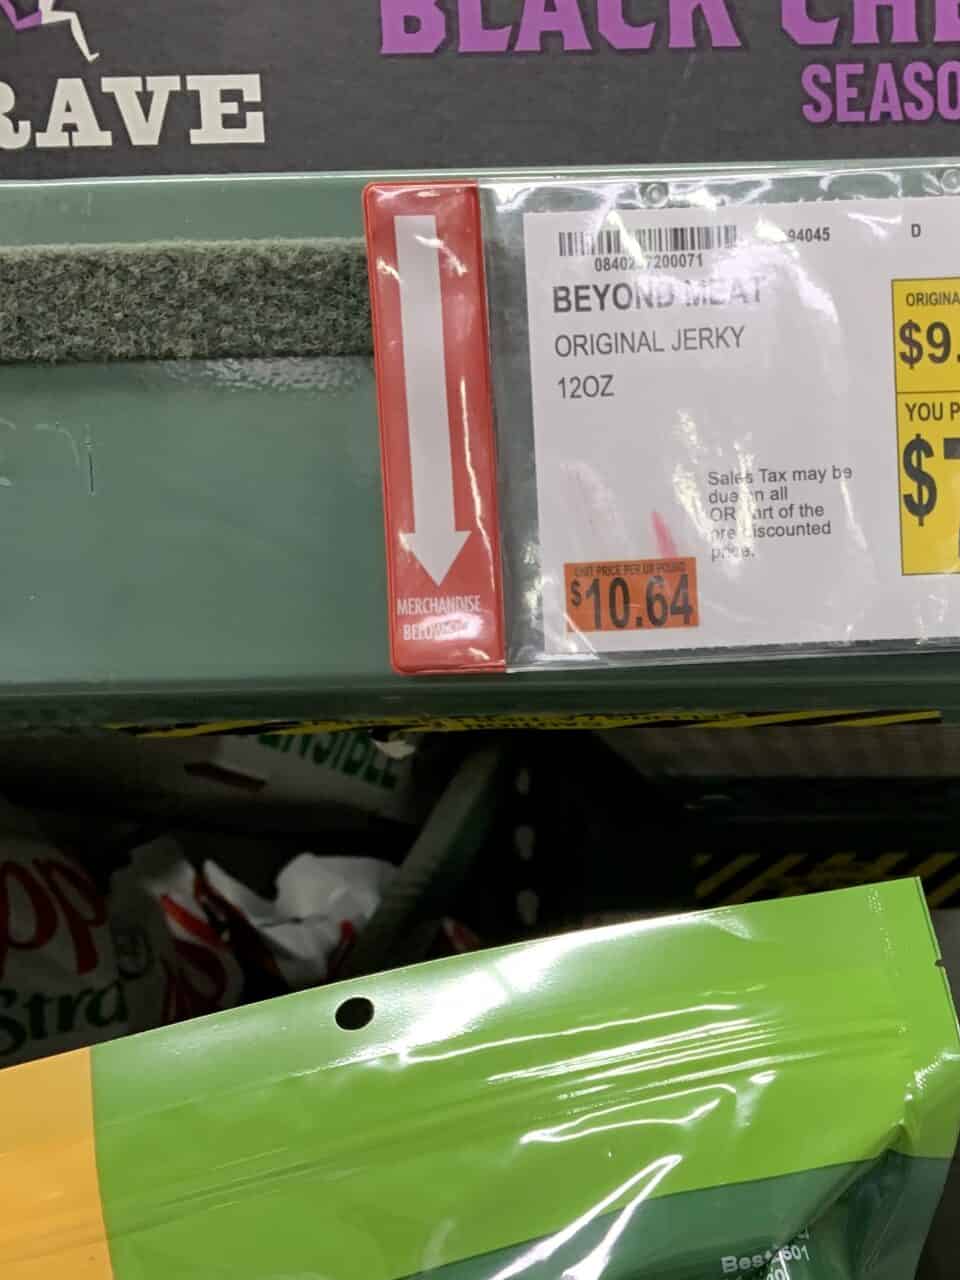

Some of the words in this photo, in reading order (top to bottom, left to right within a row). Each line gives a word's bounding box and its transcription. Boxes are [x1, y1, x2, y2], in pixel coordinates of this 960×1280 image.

[911, 223, 921, 238] D
[553, 280, 675, 314] BEYOND
[554, 330, 664, 358] ORIGINAL
[671, 325, 745, 351] JERKY
[905, 401, 944, 422] YOU
[708, 471, 753, 486] Sales
[760, 468, 788, 482] Tax
[792, 469, 827, 484] may
[832, 465, 853, 480] be
[770, 486, 788, 500] all
[778, 503, 794, 519] of
[799, 503, 825, 518] the
[396, 594, 481, 616] MERCHANDISE
[570, 573, 693, 631] $10.64
